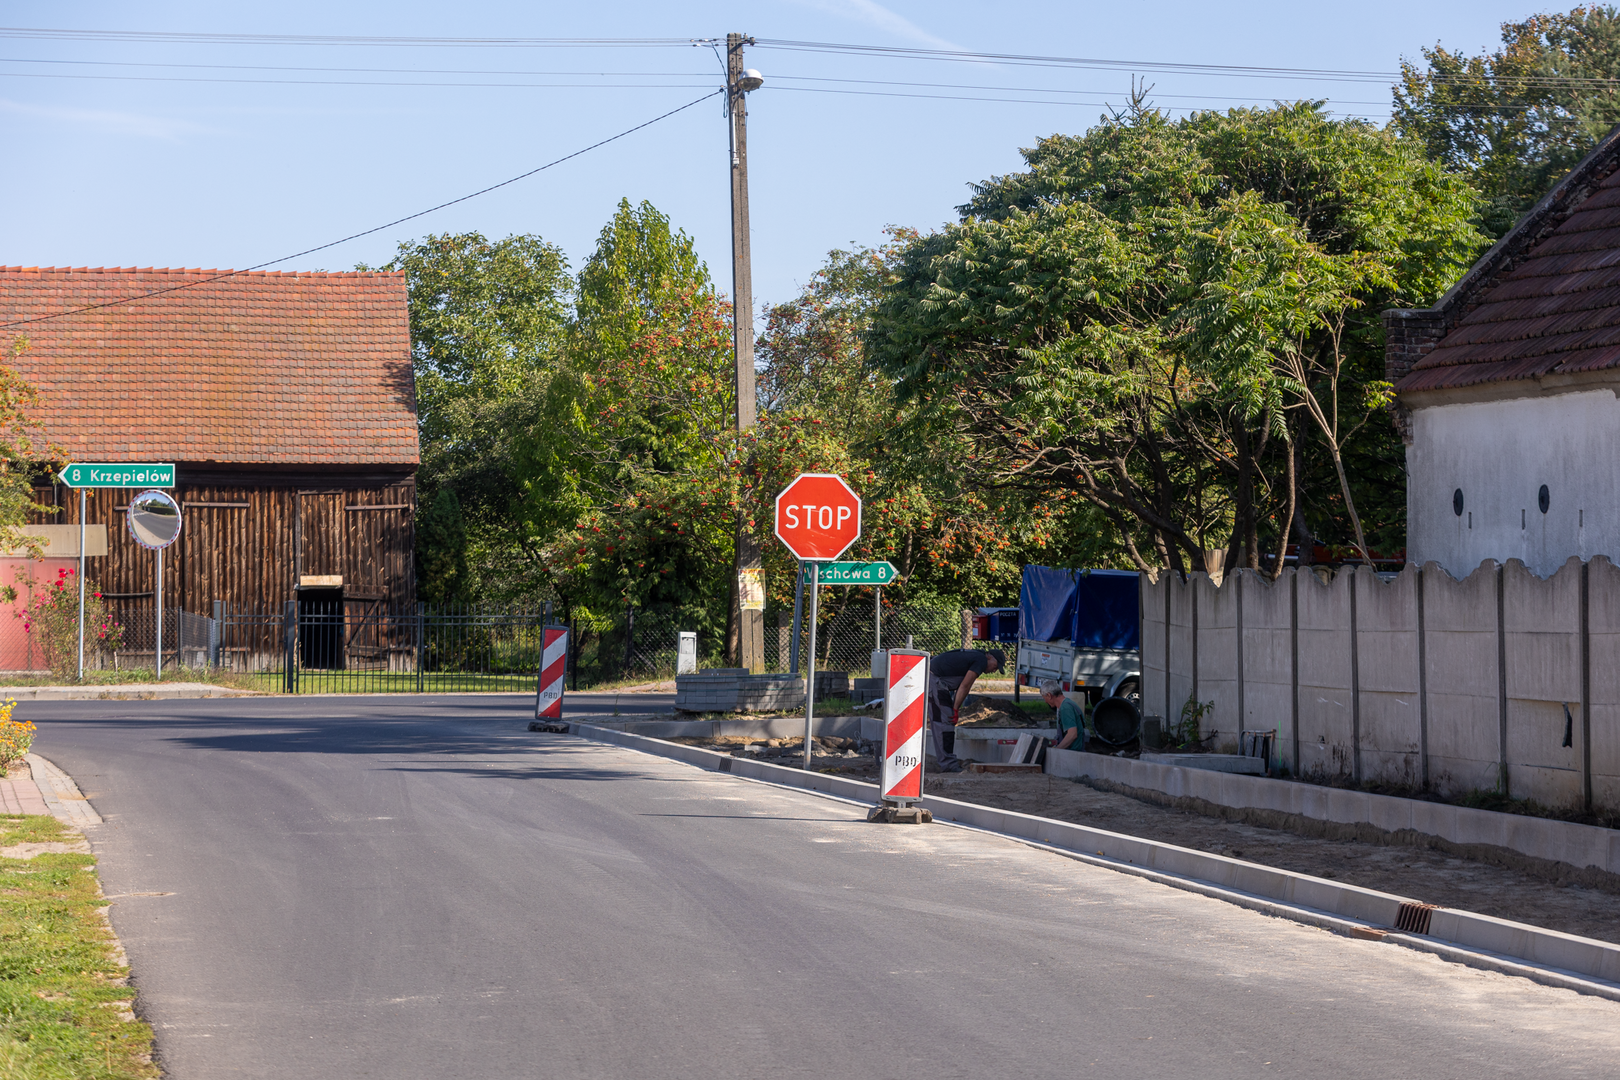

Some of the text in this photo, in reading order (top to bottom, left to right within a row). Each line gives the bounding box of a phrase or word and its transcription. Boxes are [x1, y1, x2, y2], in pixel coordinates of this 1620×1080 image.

[72, 469, 171, 485] 8 Krzepielów
[785, 504, 852, 530] STOP
[878, 566, 886, 579] 8
